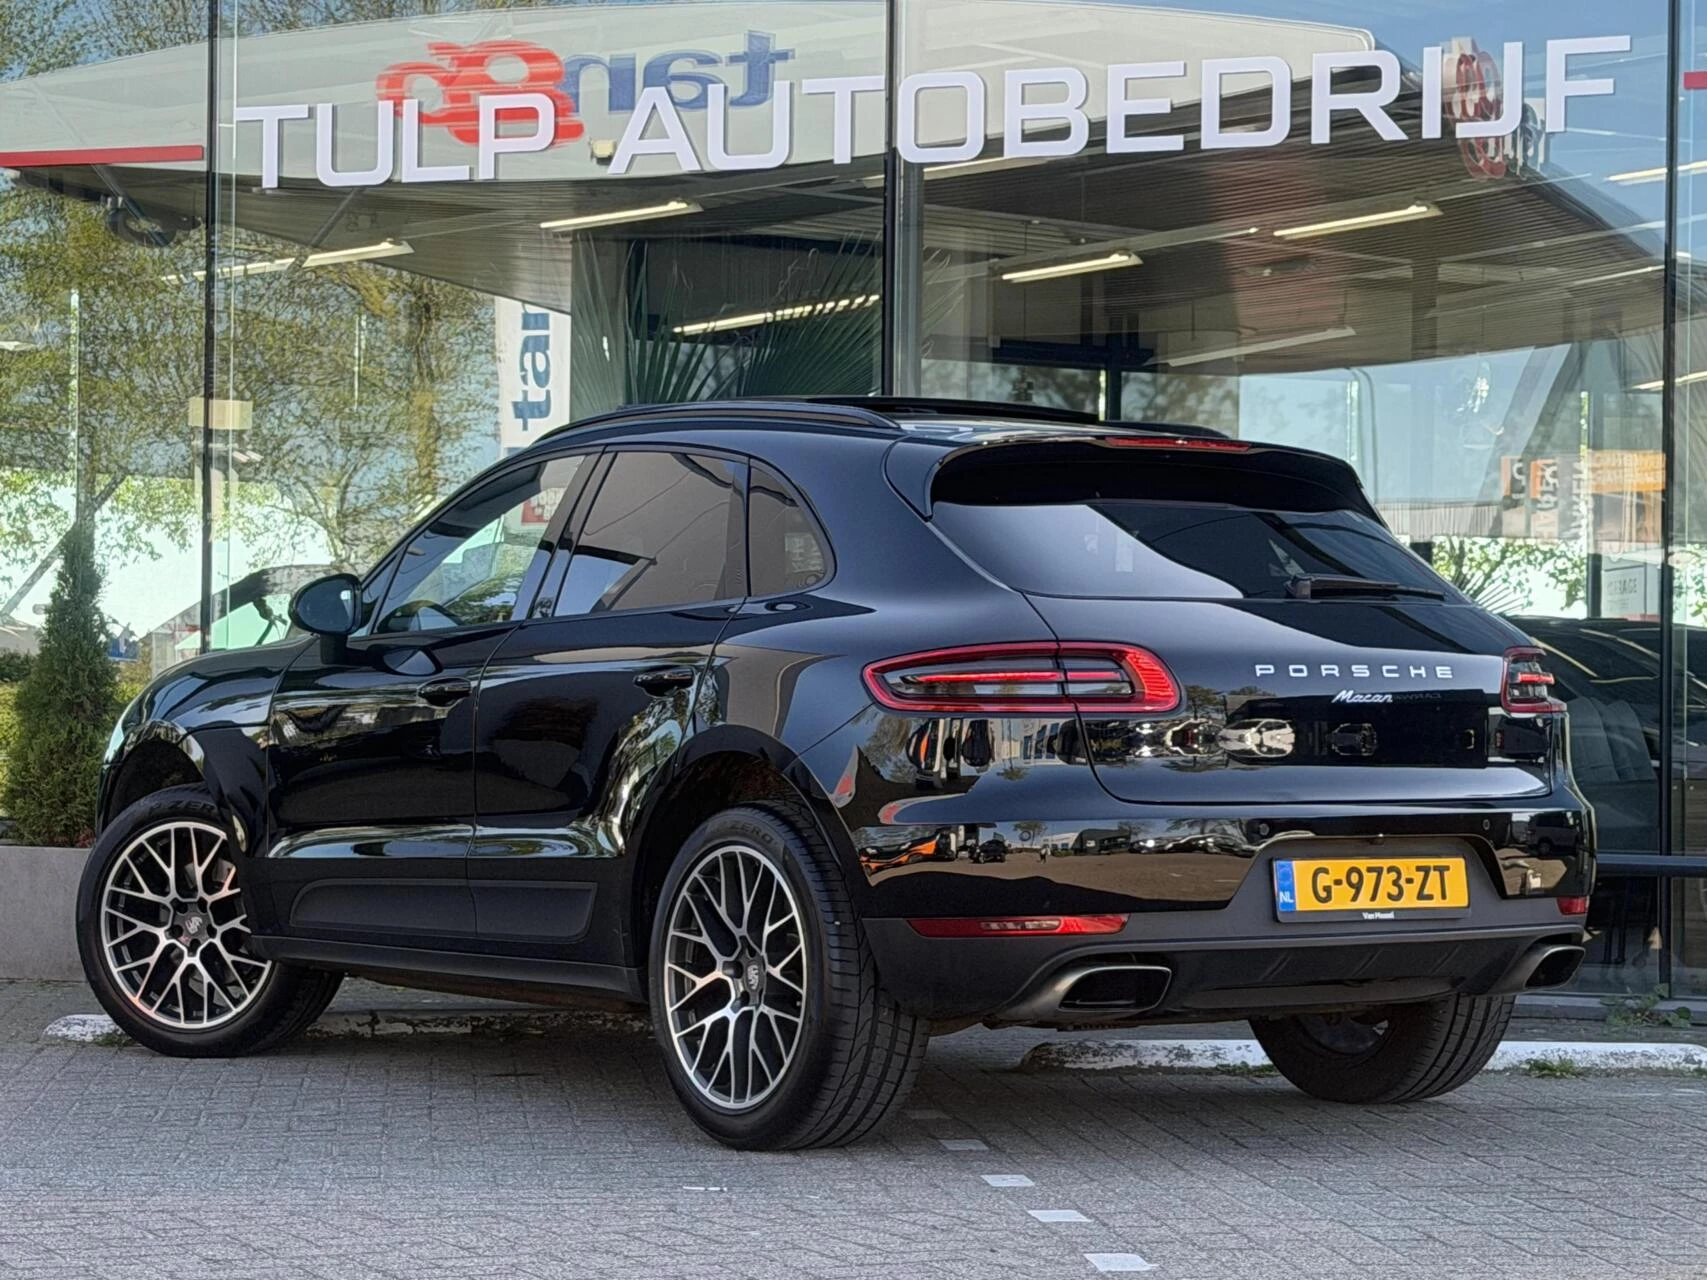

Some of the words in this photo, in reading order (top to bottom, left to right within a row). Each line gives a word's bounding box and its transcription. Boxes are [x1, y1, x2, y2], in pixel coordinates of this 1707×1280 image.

[233, 93, 557, 190] TULP
[608, 35, 1632, 174] AUTOBEDRIJF
[1255, 664, 1453, 678] PORSCHE
[1331, 689, 1394, 704] Macan
[1311, 865, 1450, 904] G-973-ZT
[1279, 891, 1295, 904] NL
